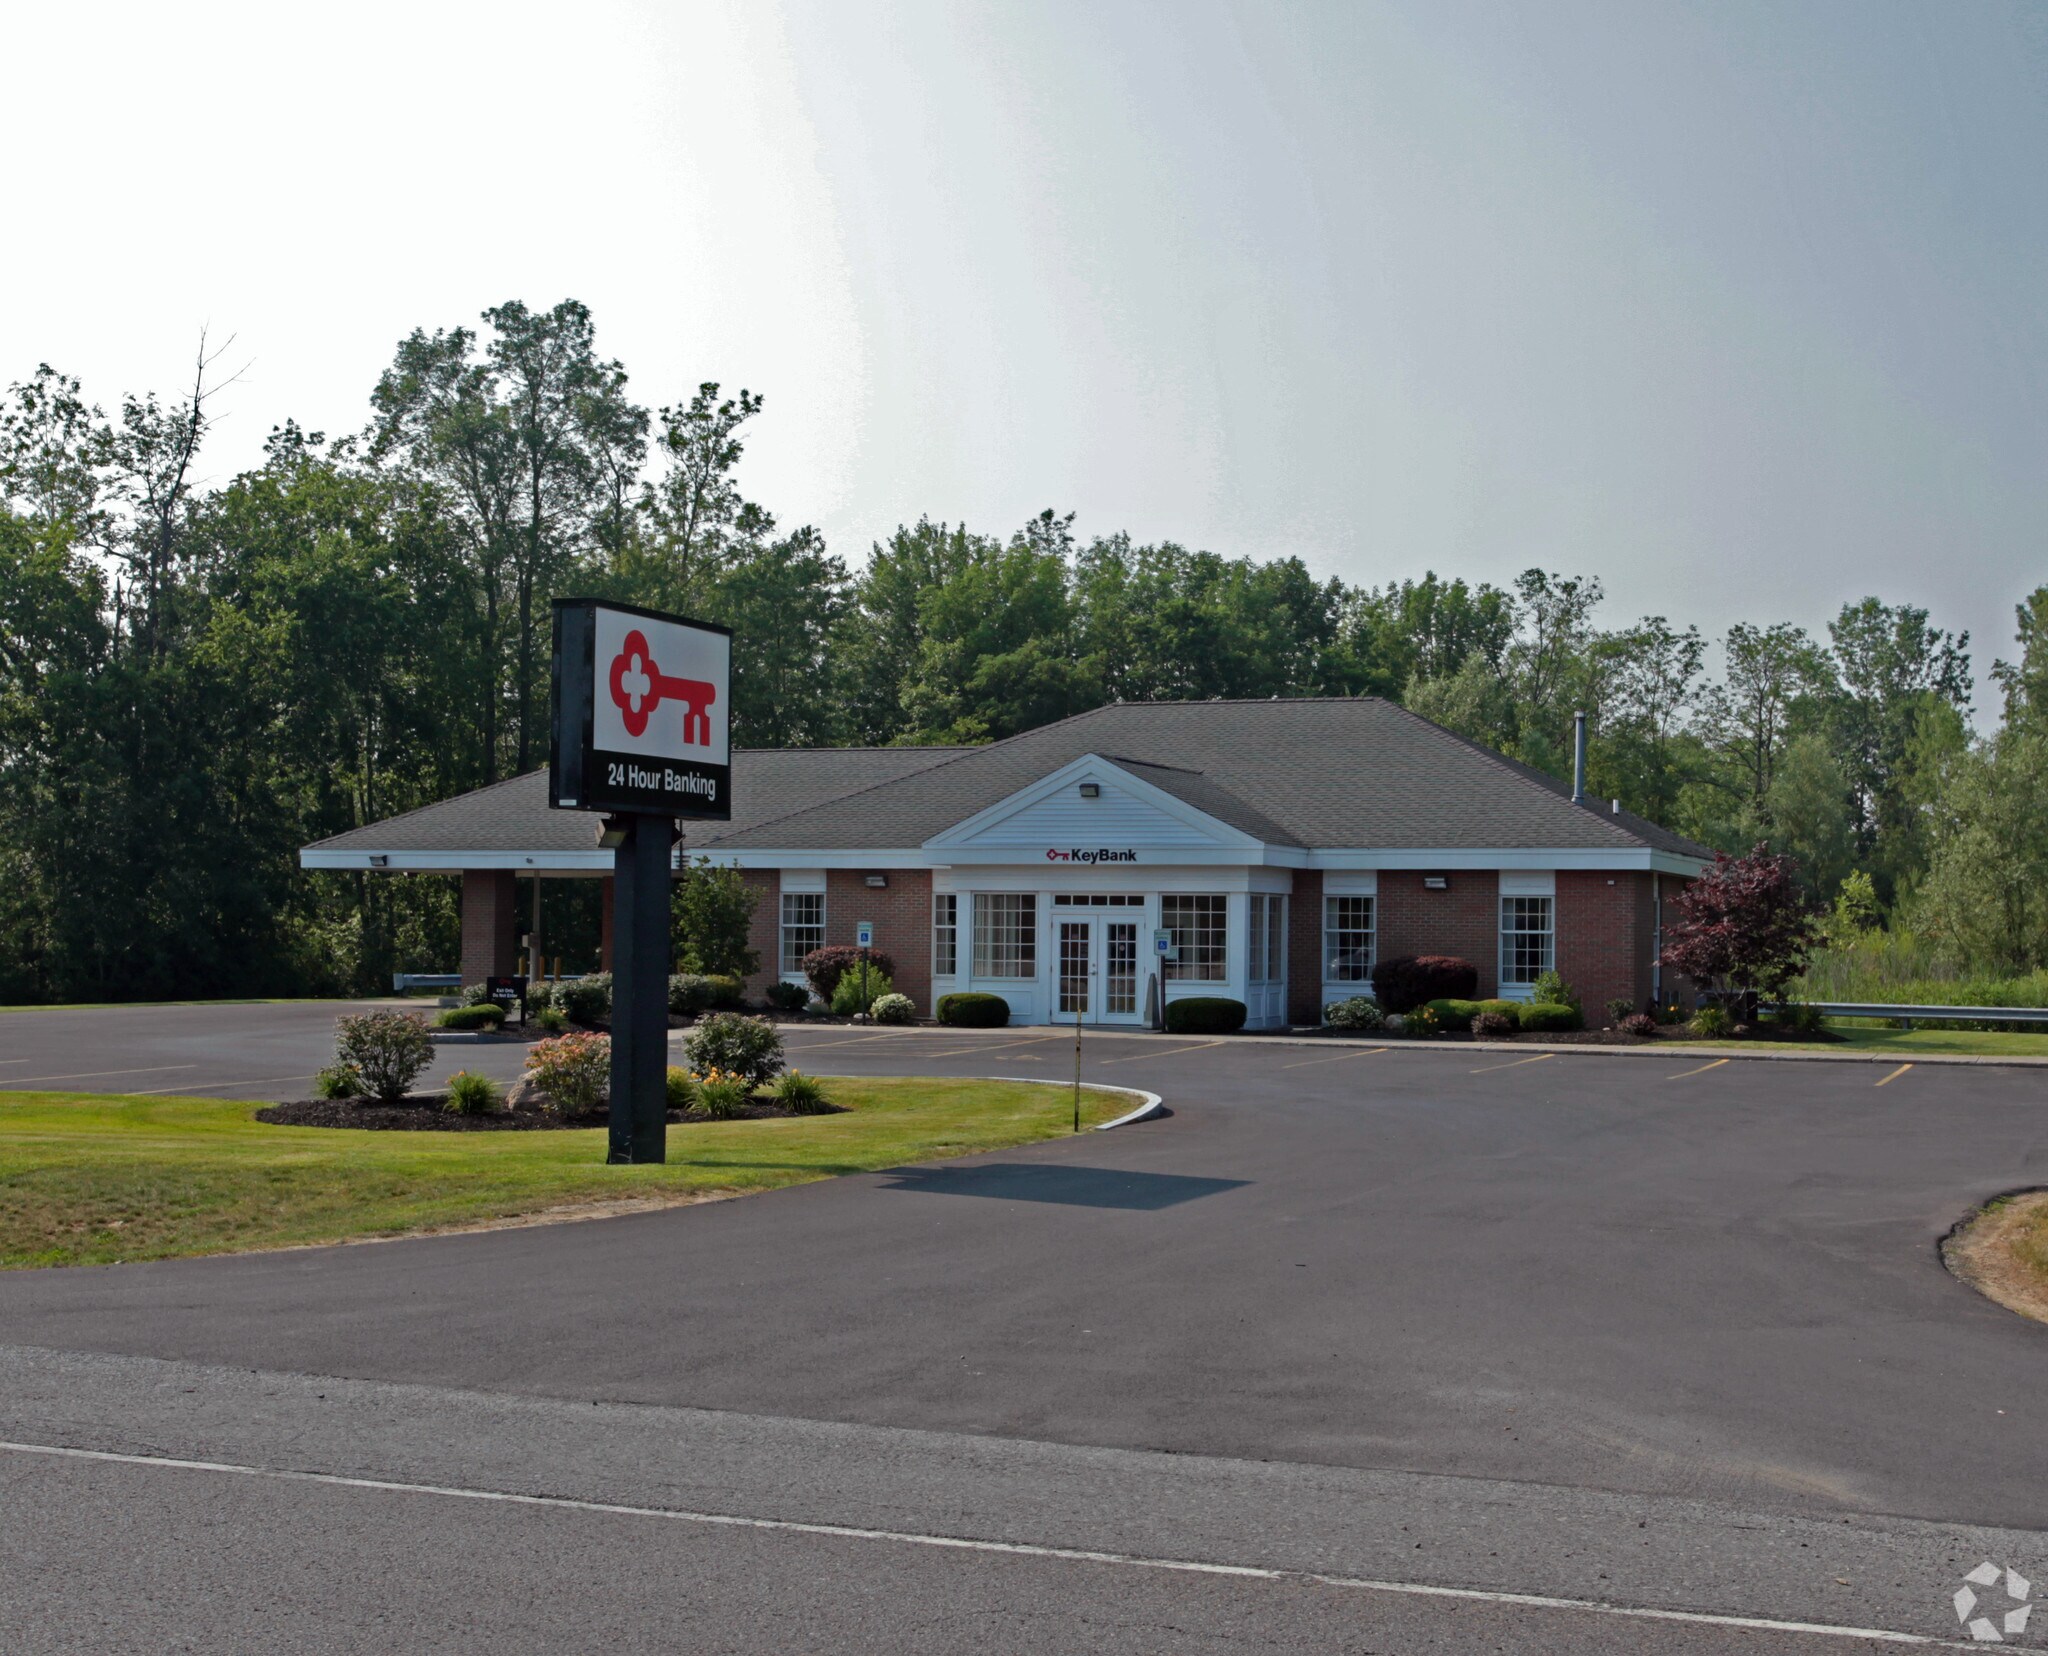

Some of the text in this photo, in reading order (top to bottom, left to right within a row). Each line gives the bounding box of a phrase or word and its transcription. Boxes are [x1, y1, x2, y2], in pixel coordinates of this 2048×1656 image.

[608, 763, 716, 801] 24 Hour Banking
[1071, 848, 1137, 865] KeyBank
